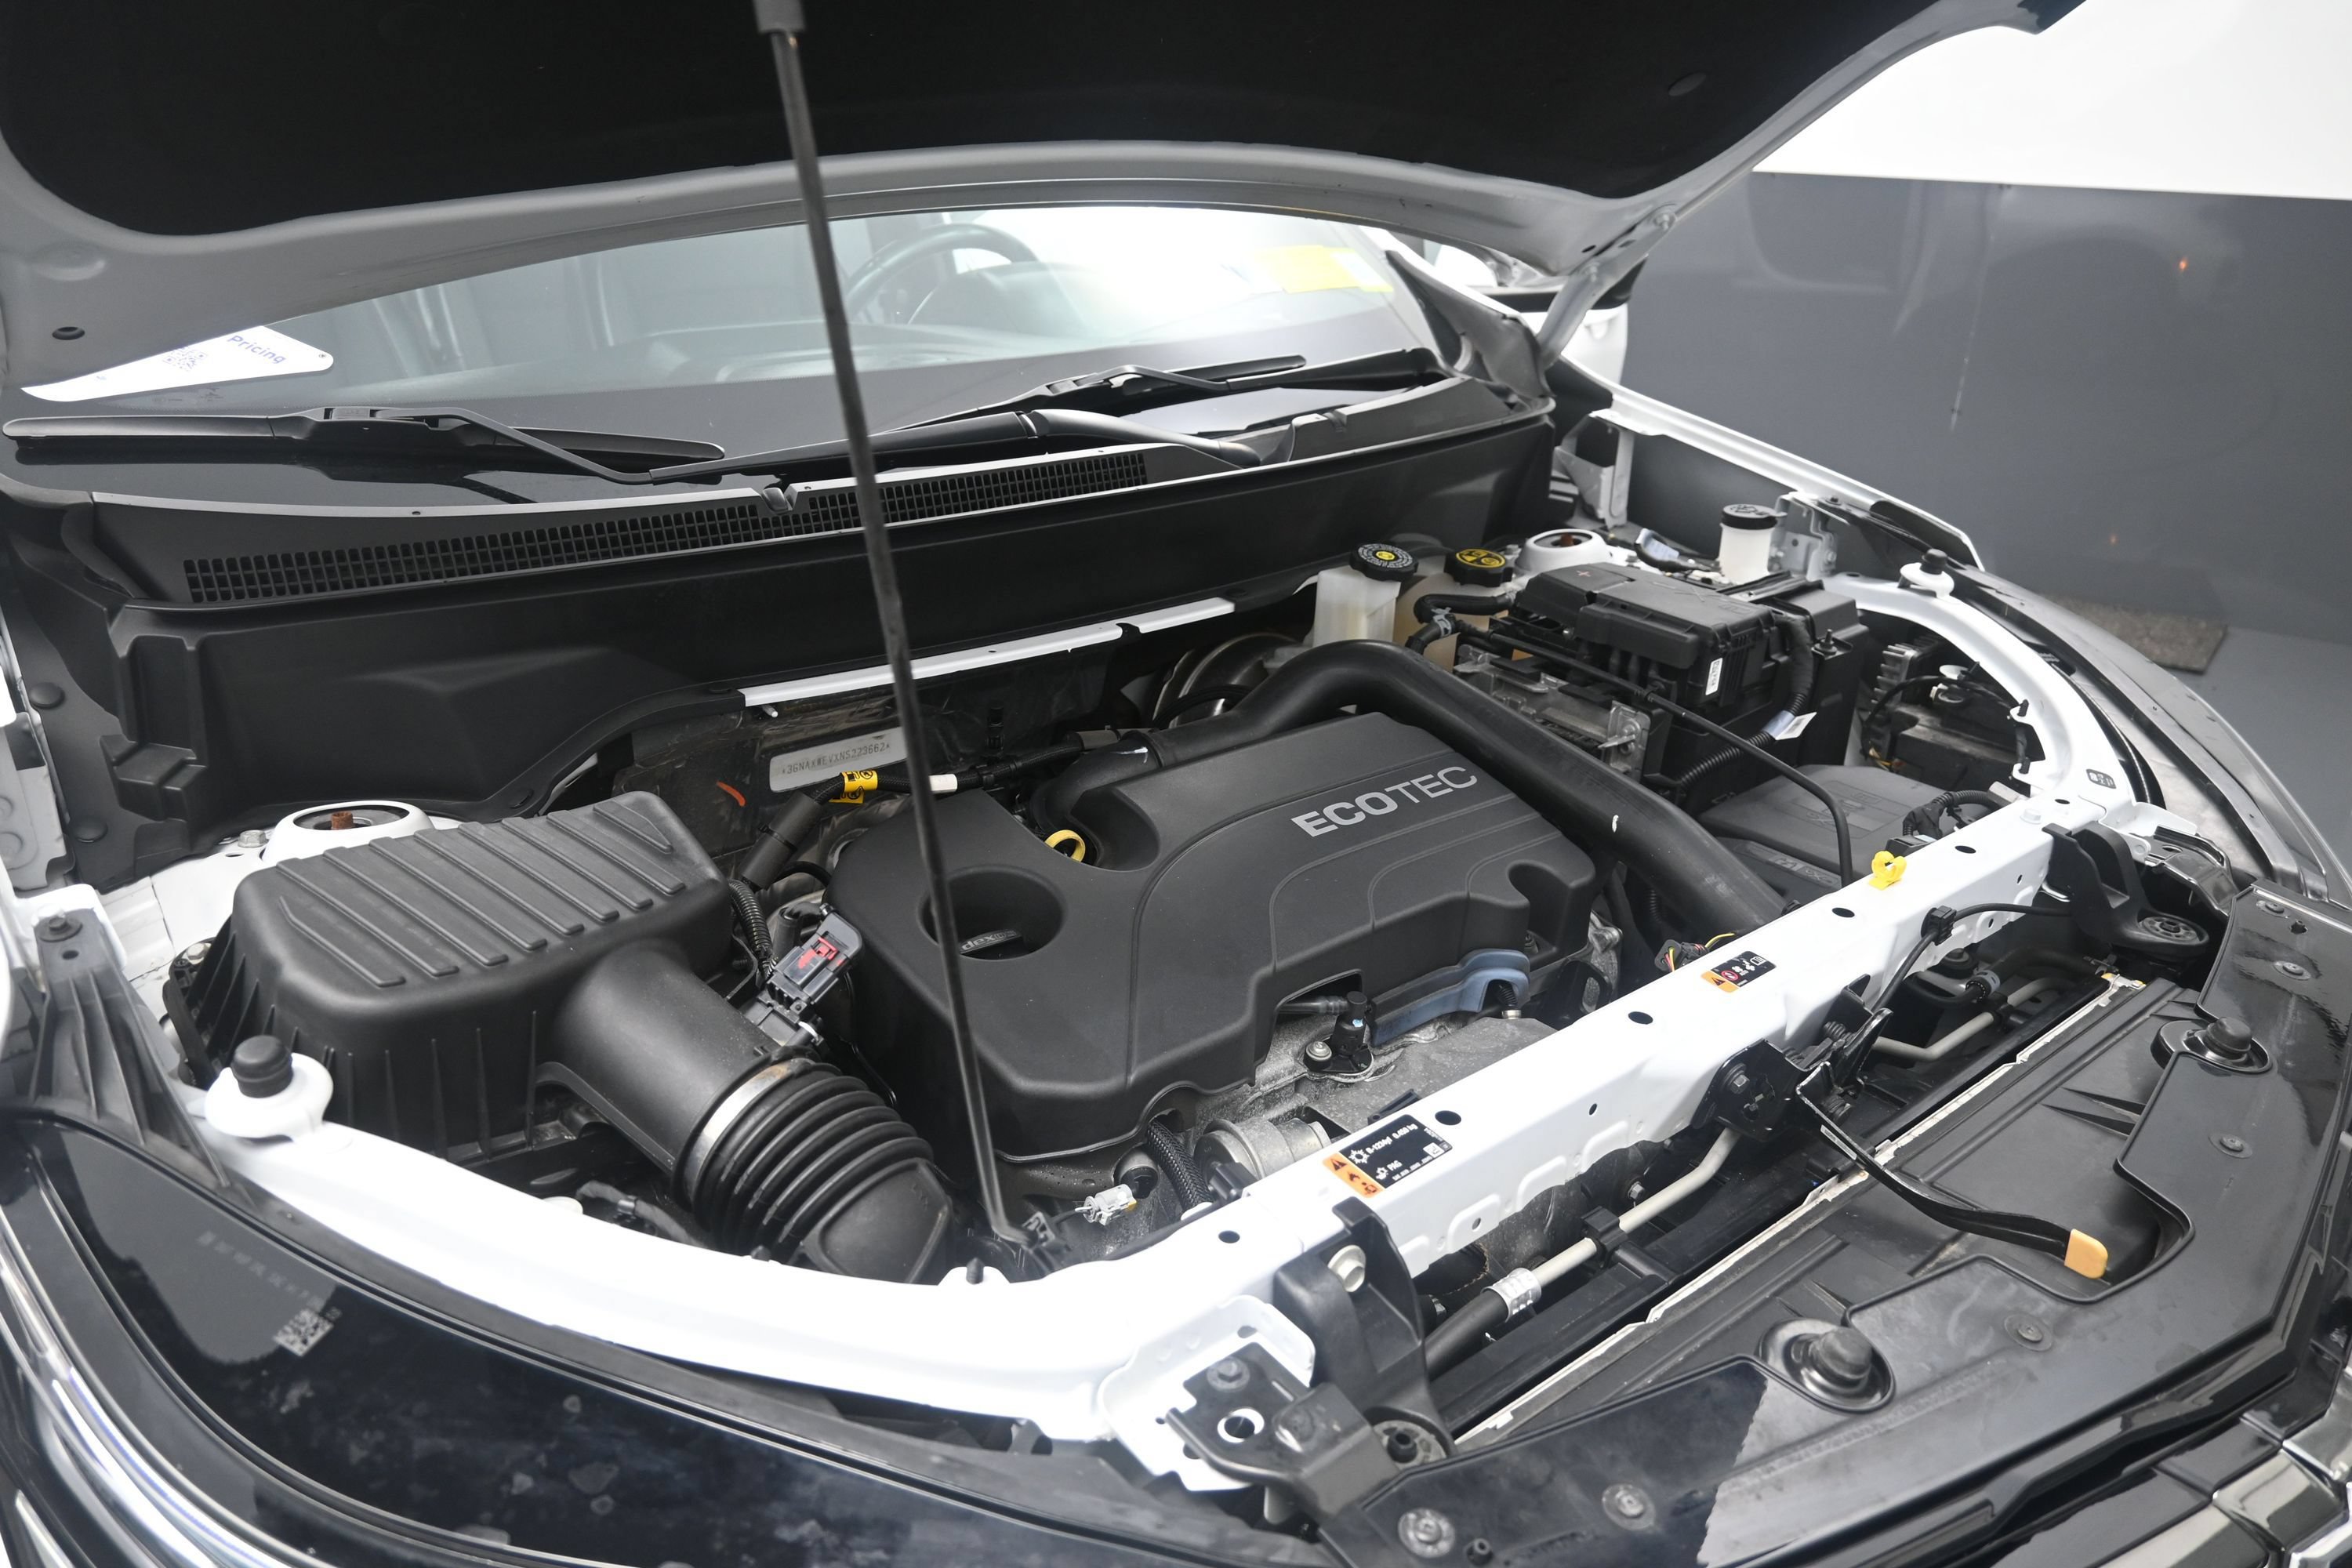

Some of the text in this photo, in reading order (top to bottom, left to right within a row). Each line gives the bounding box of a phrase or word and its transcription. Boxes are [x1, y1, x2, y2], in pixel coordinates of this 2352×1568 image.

[227, 335, 287, 365] Pricing
[1290, 766, 1478, 837] ECOTEC
[1386, 1160, 1403, 1171] PAG
